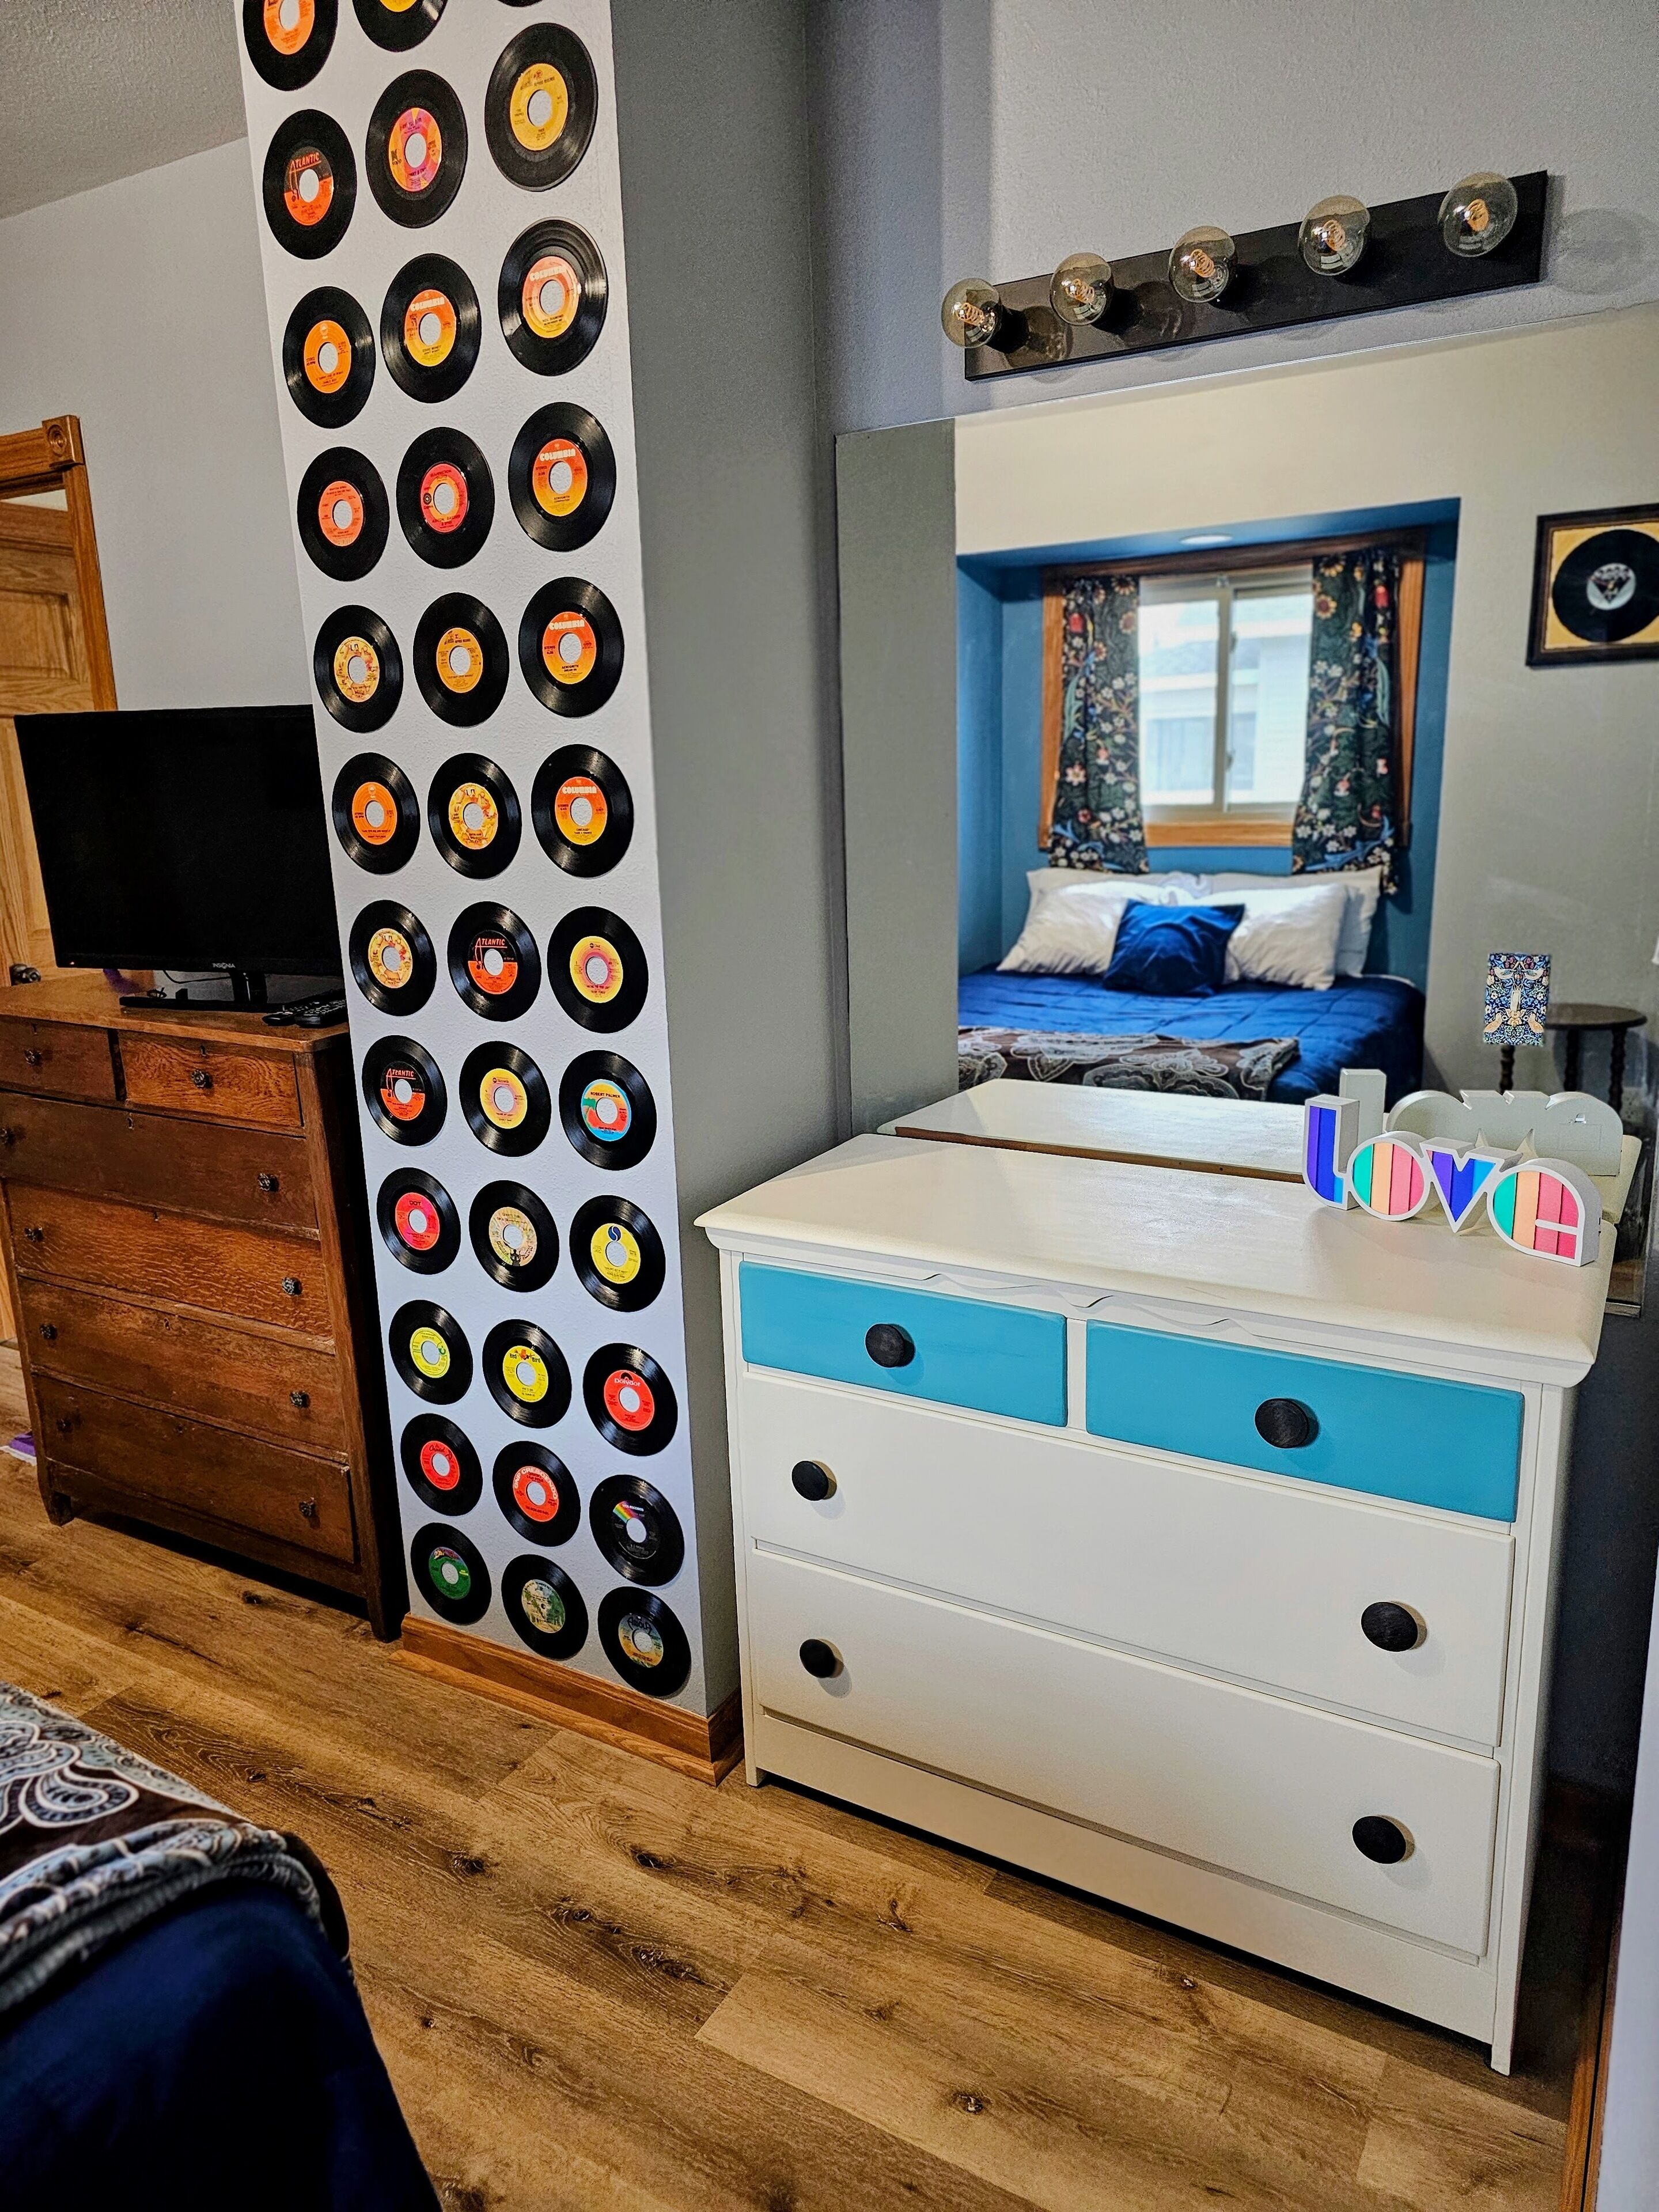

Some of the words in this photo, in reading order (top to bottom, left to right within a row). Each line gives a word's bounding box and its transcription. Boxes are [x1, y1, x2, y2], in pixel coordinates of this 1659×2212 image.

[289, 151, 320, 173] ATLANTIC
[410, 296, 445, 312] COLUMBIA
[539, 448, 576, 461] COLUMBIA
[548, 619, 585, 630] COLUMBIA
[562, 786, 597, 794] COLUMBIA
[475, 937, 506, 948] ATLANTIC
[386, 1068, 415, 1078] ATLANTIC
[613, 1378, 641, 1387] Polydor
[513, 1472, 521, 1490] GNP
[521, 1467, 558, 1500] CRESCENDO
